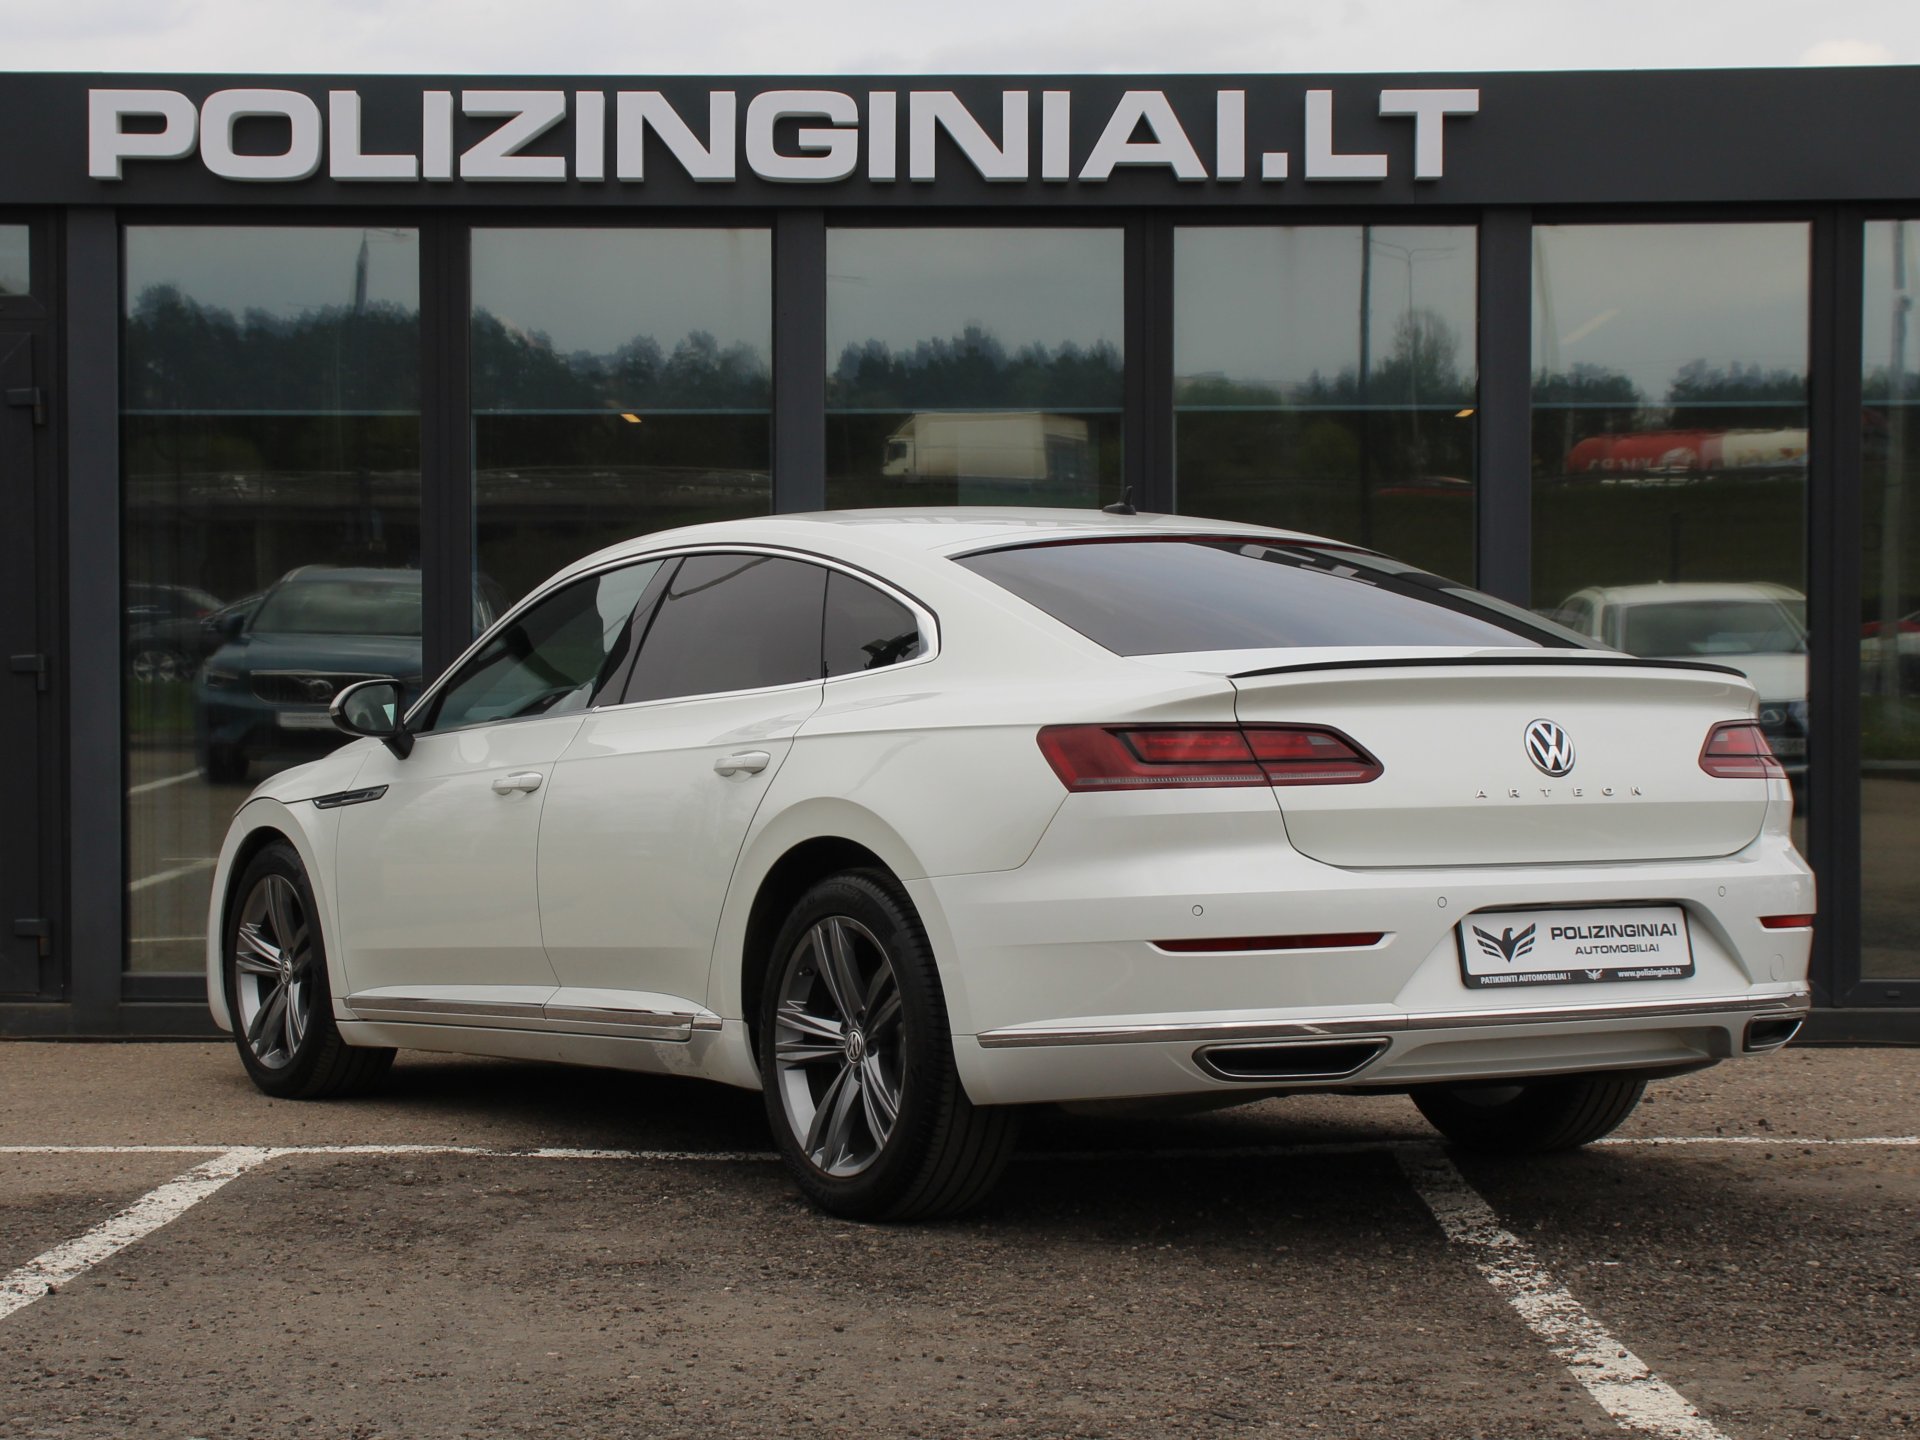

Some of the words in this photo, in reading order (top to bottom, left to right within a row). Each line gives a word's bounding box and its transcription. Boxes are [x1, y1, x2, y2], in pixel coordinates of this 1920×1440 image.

[88, 88, 1481, 183] POLIZINGINIAI.LT
[1475, 786, 1642, 799] ARTEON
[1551, 923, 1678, 941] POLIZINGINIAI
[1575, 944, 1660, 956] AUTOMOBILIAI
[1480, 974, 1518, 985] PATIKRINTI
[1518, 972, 1567, 983] AUTOMOBILIAI
[1617, 967, 1682, 978] www.polizinginiai.lt
